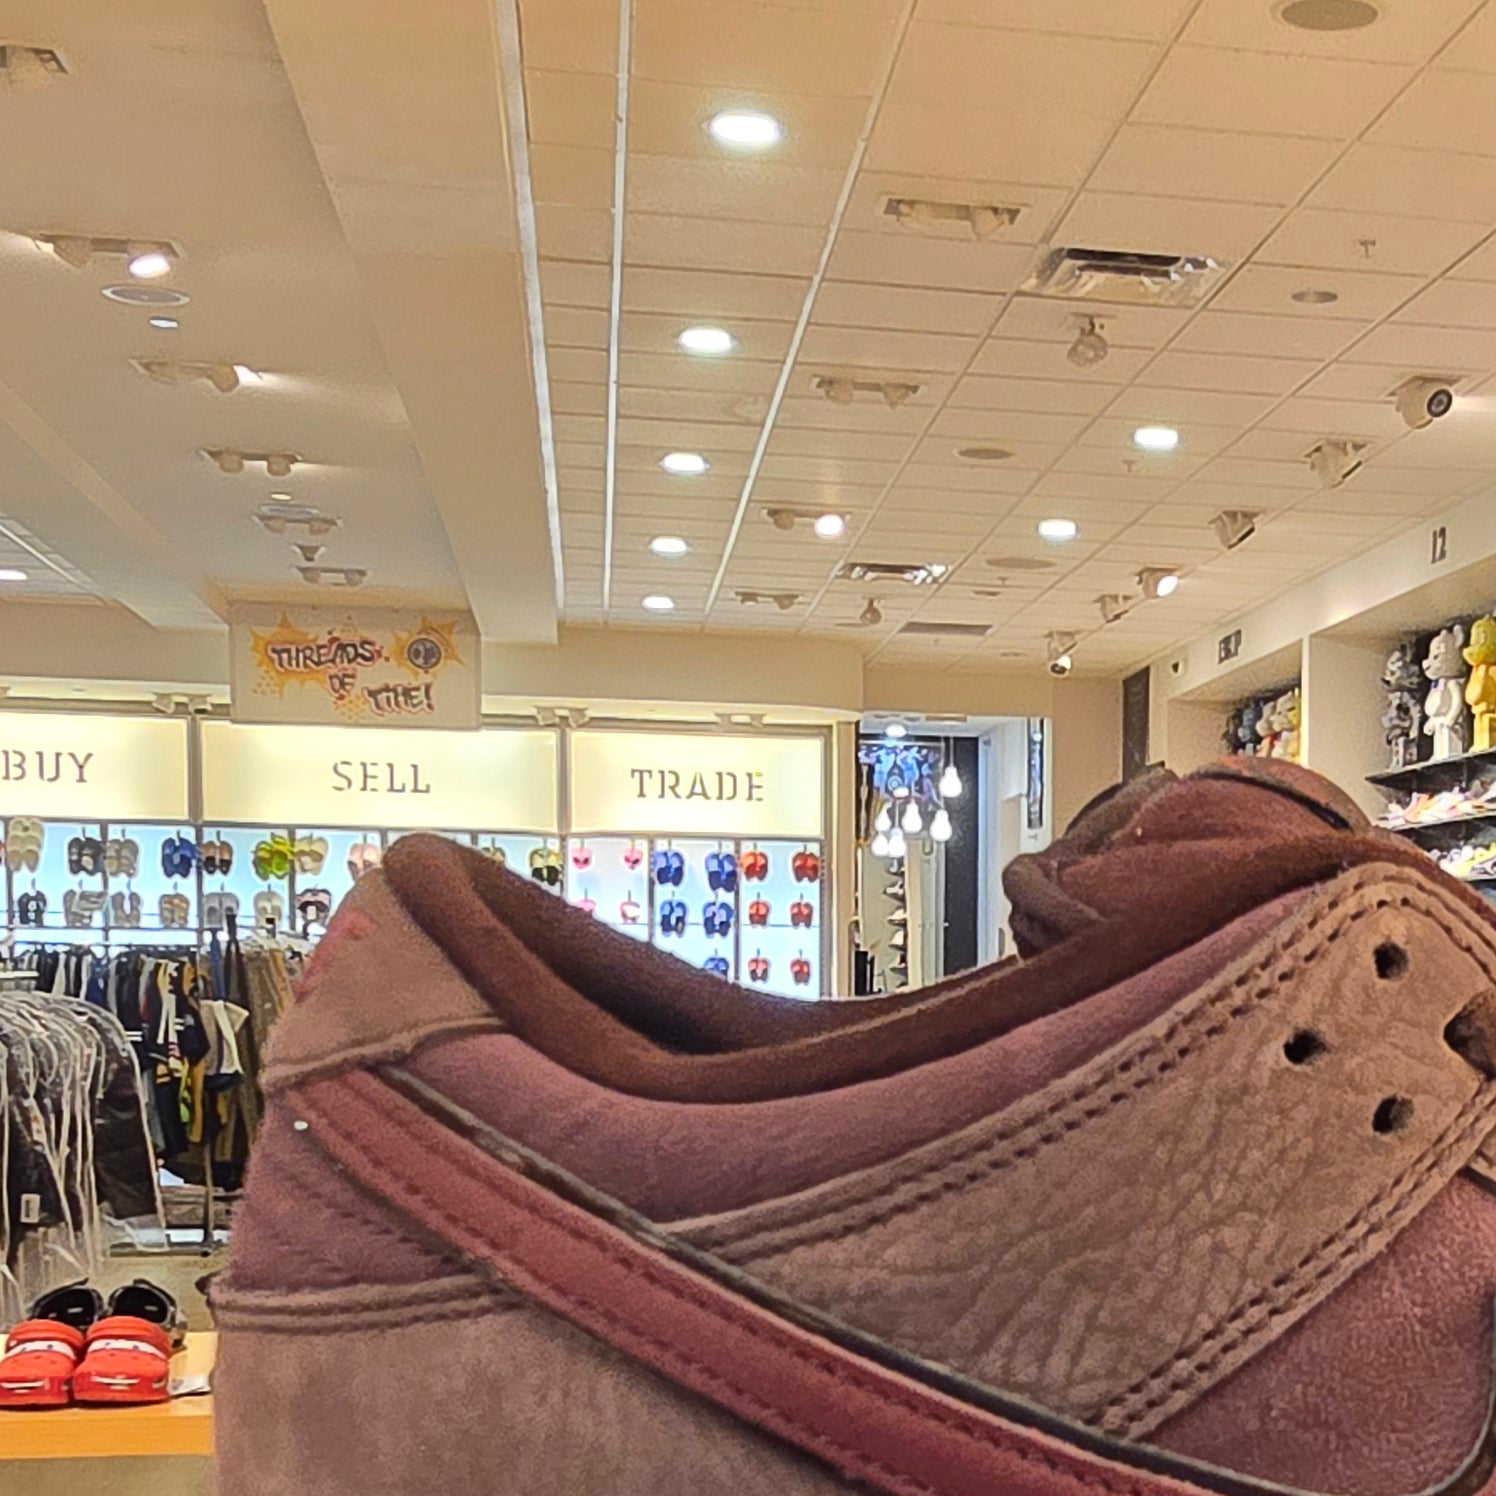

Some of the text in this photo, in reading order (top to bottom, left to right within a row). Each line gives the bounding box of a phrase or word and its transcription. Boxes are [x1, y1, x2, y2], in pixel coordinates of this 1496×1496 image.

[1431, 526, 1447, 564] 12
[270, 640, 375, 669] THREADS
[2, 749, 94, 783] BUY
[332, 760, 431, 794] SELL
[630, 768, 764, 802] TRADE
